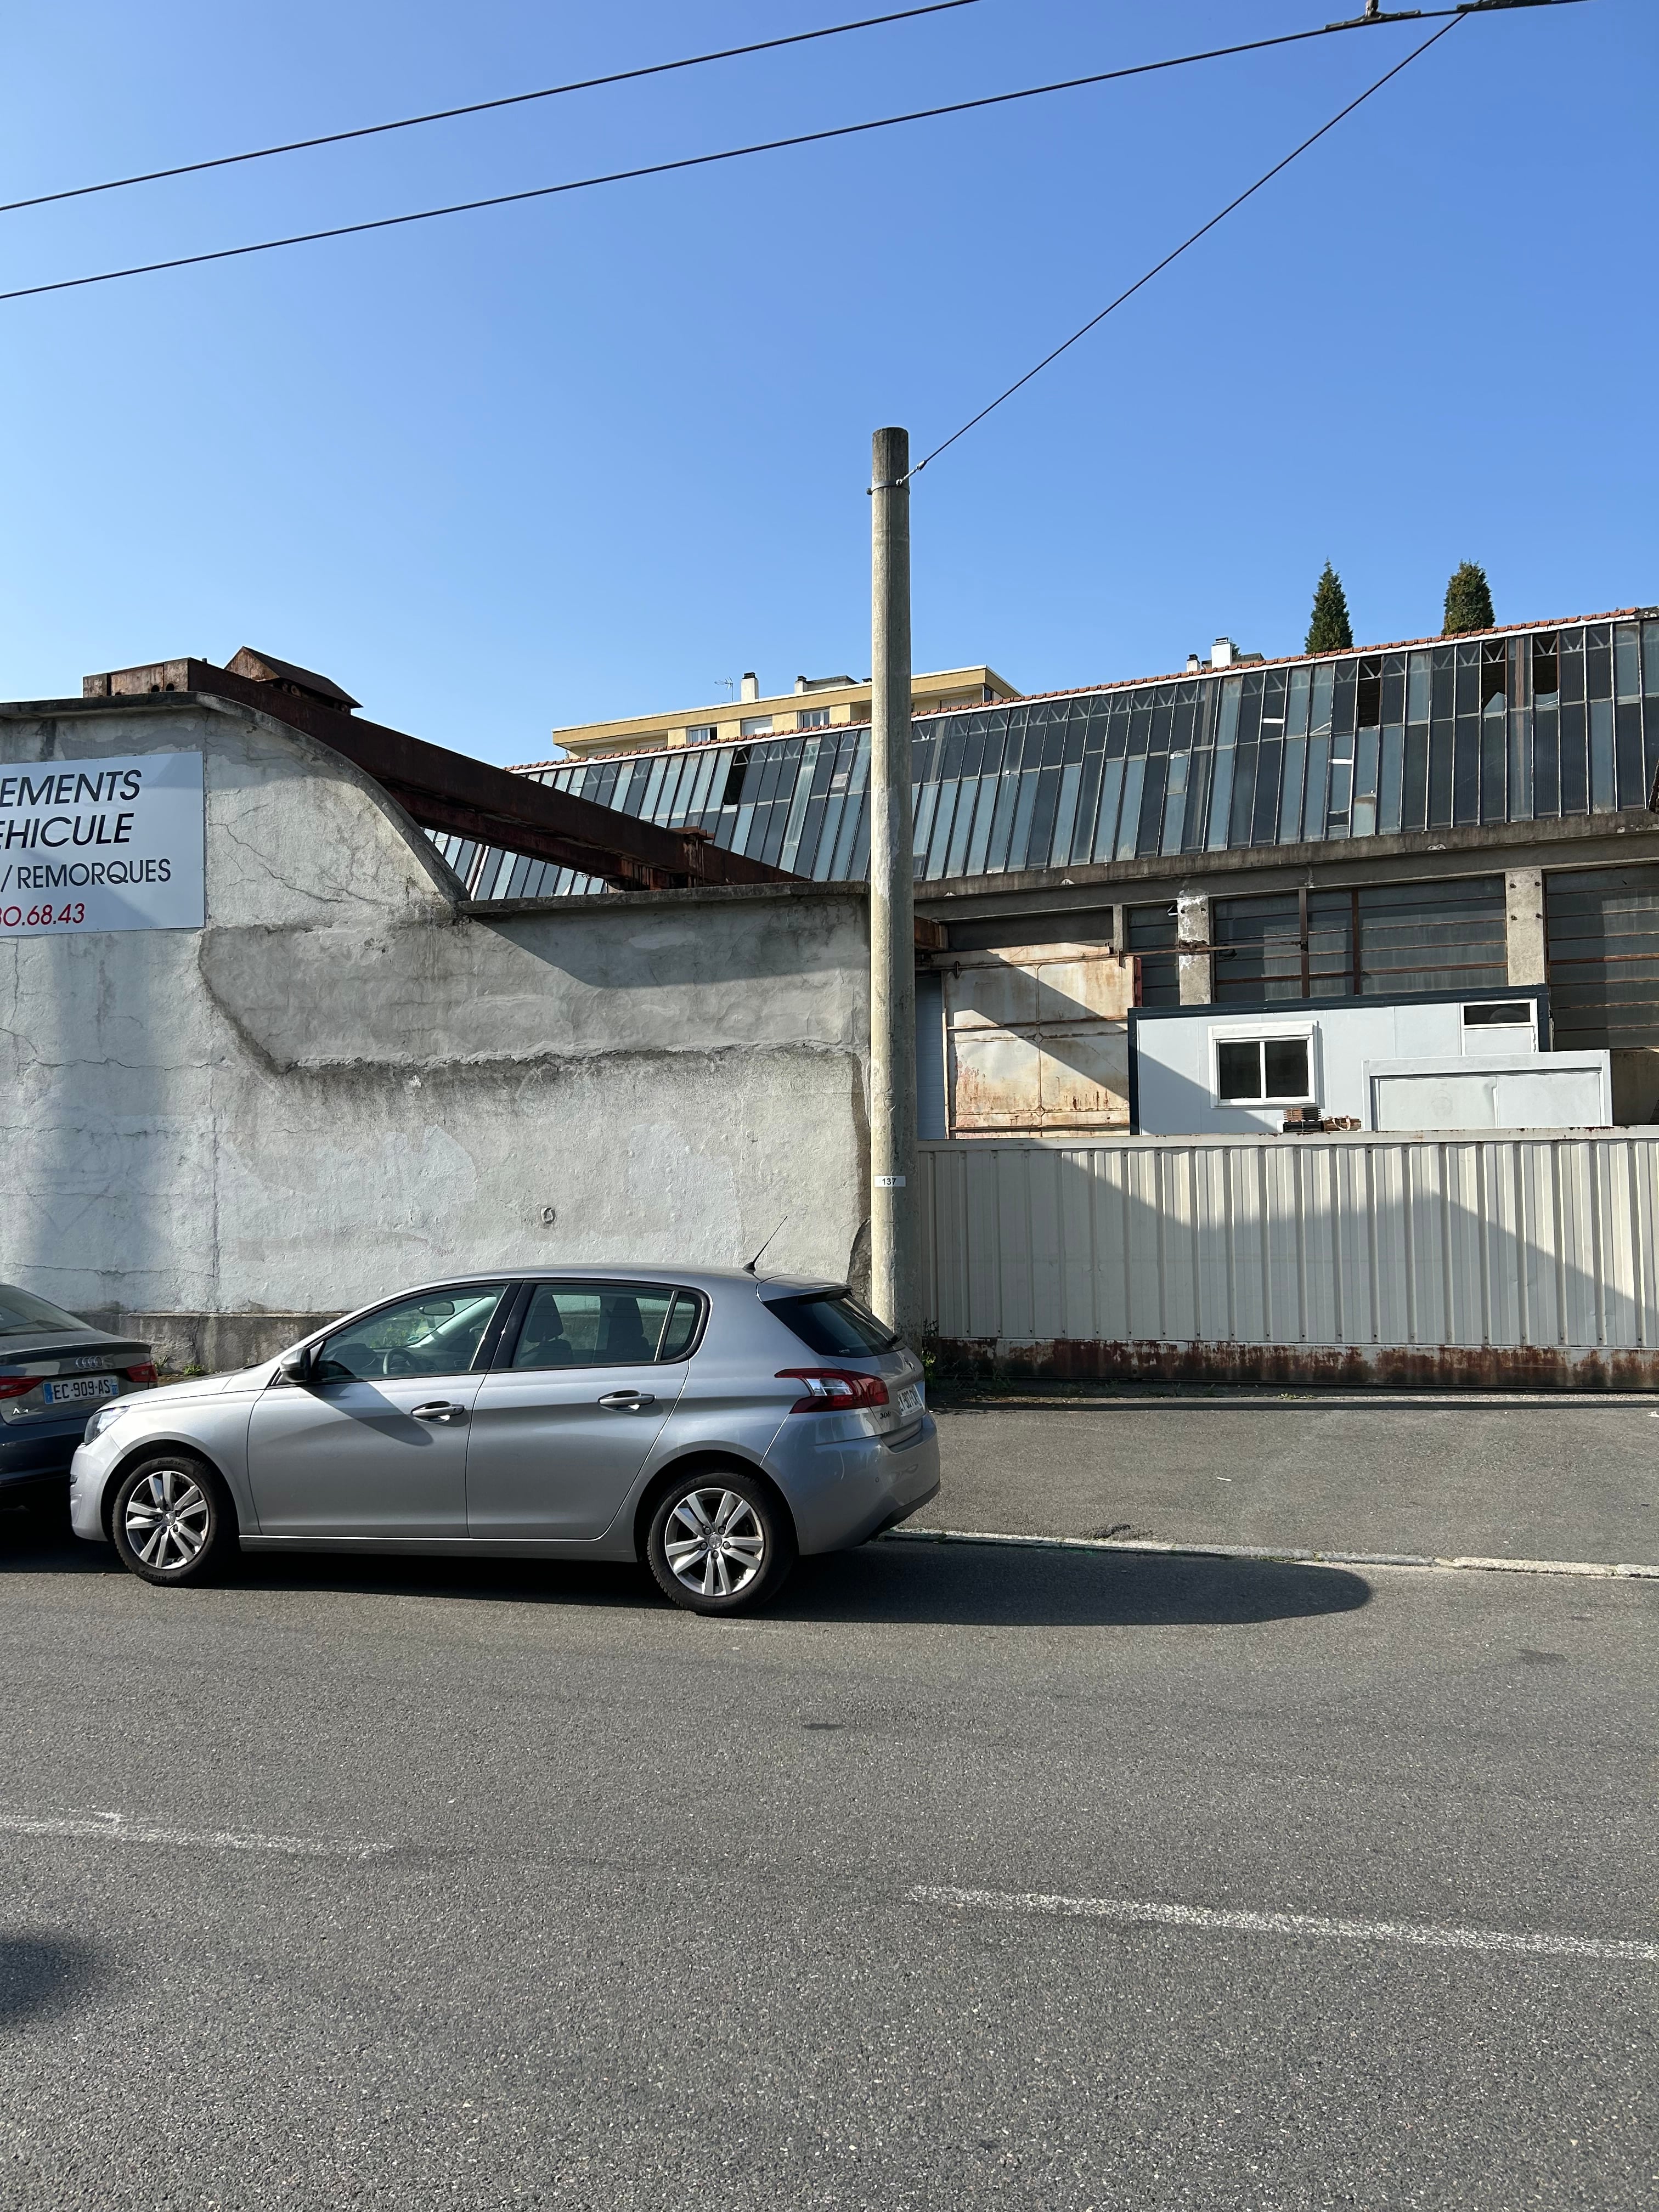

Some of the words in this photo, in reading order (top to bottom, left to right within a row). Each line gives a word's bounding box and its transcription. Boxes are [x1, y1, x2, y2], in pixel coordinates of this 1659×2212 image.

[0, 769, 142, 807] EMENTS
[0, 903, 84, 927] 0.68.43
[53, 1379, 110, 1400] EC-909-AS
